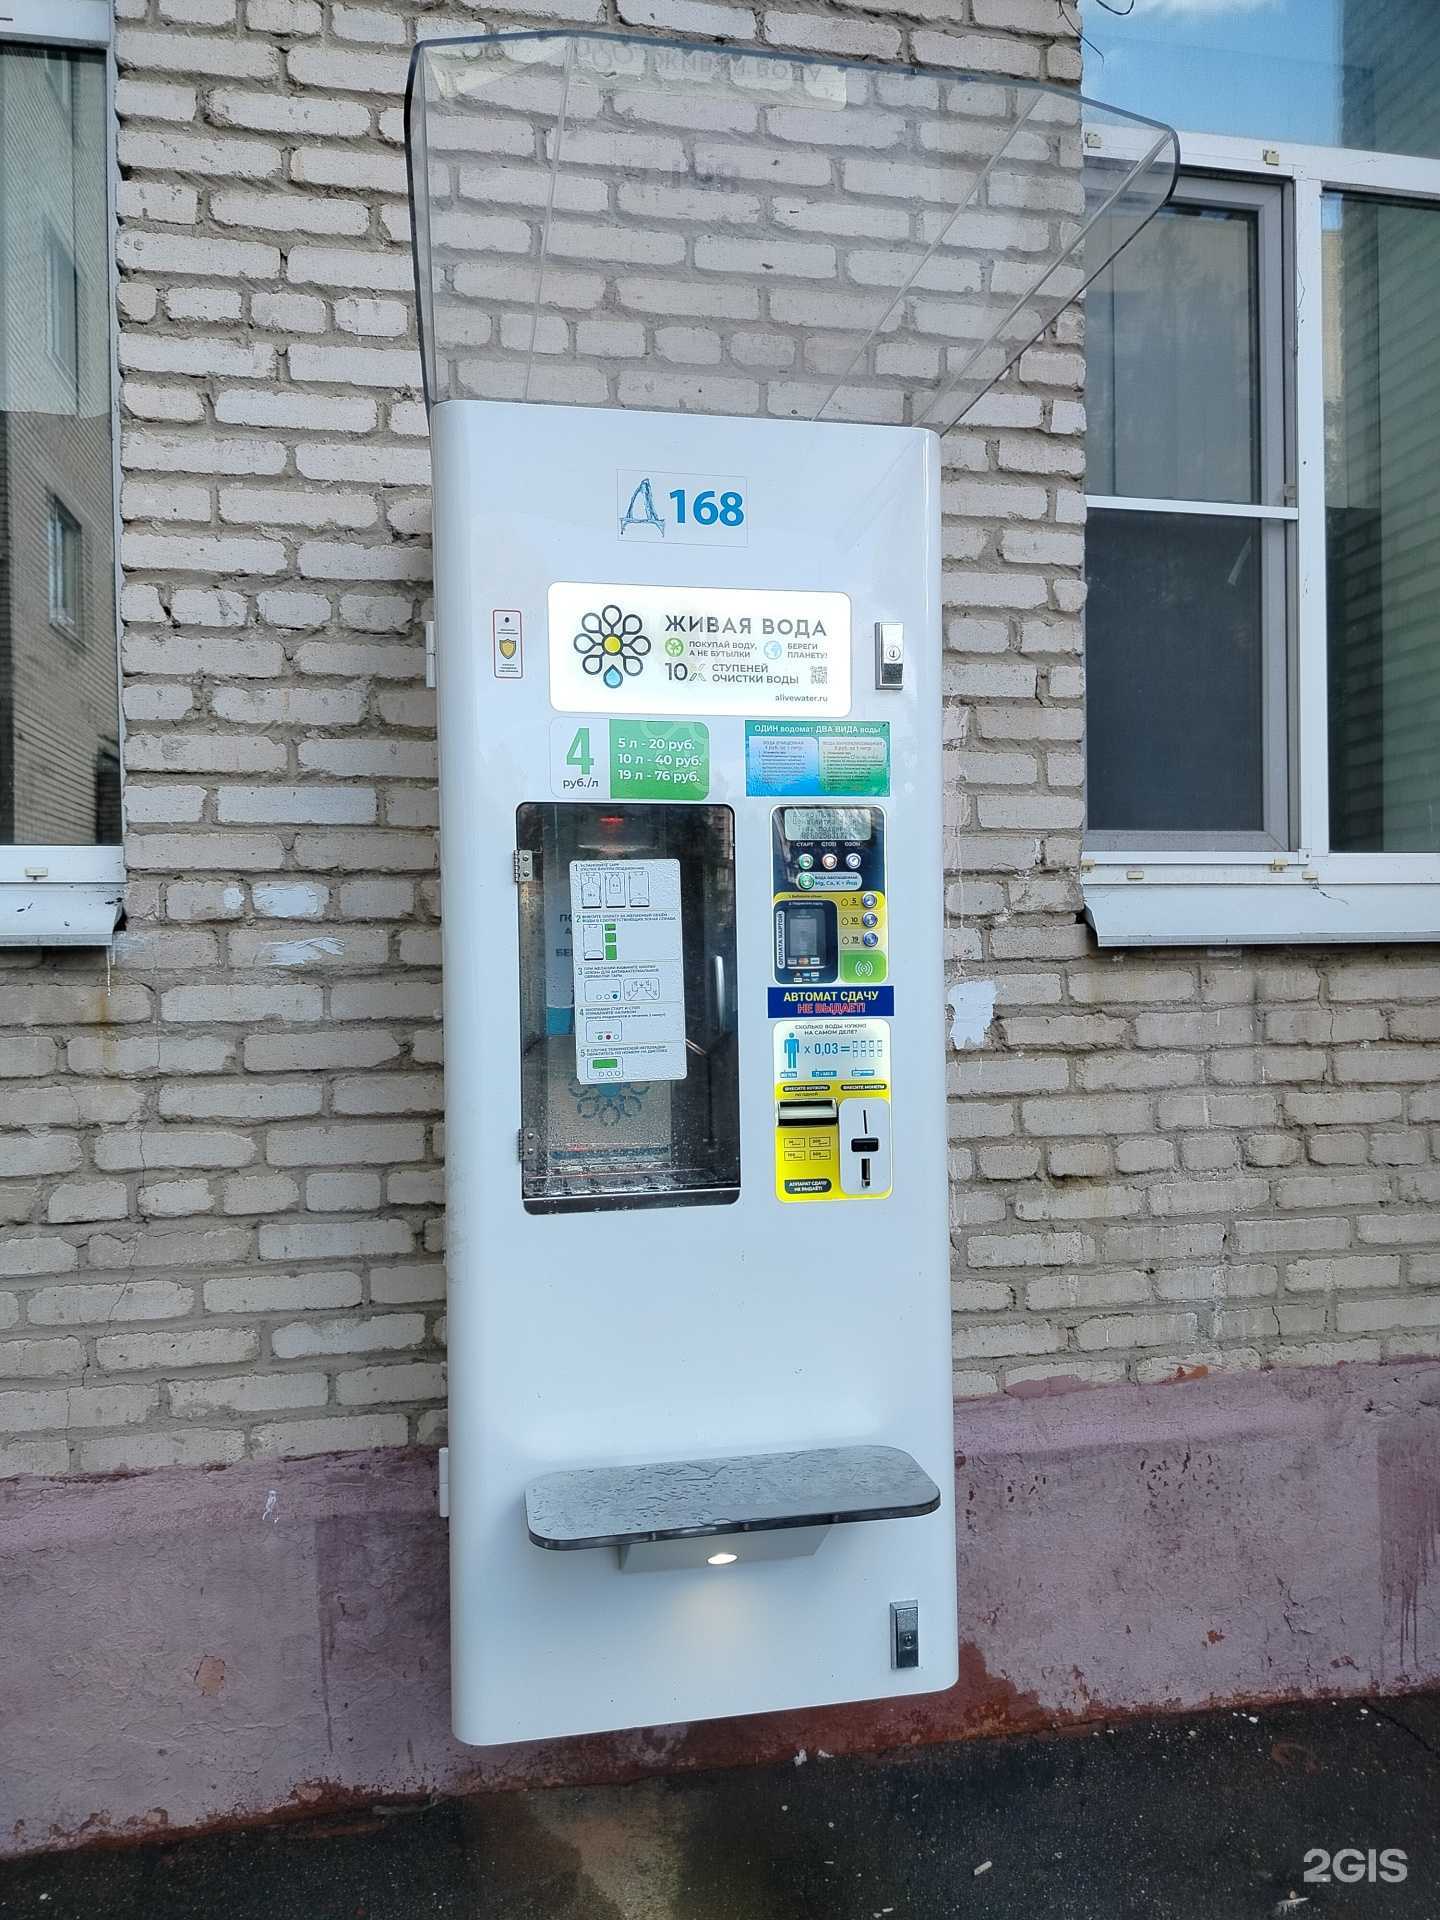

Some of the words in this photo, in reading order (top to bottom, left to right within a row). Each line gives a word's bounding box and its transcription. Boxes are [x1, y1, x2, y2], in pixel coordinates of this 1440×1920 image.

[664, 615, 751, 634] ЖИВАЯ
[762, 618, 827, 638] ВОДА
[689, 640, 730, 649] ПОКУПАЙ
[732, 642, 758, 650] ВОДУ,
[711, 650, 750, 658] БУТЫЛКИ
[787, 651, 828, 659] ПЛАНЕТУ!
[665, 663, 688, 681] 10
[712, 663, 768, 673] СТУПЕНЕЙ
[712, 674, 764, 683] ОЧИСТКИ
[767, 675, 799, 685] ВОДЫ
[775, 694, 828, 703] alivewater.ru
[754, 725, 779, 733] ОДИН
[815, 725, 833, 734] ДВА
[835, 726, 858, 734] ВИДА
[860, 727, 880, 735] воды
[618, 737, 626, 748] 5
[629, 740, 638, 748] л
[649, 738, 665, 749] 20
[668, 739, 695, 752] руб.
[566, 727, 595, 775] 4
[618, 753, 631, 764] 10
[635, 755, 644, 764] л
[655, 754, 672, 765] 40
[675, 755, 702, 768] руб.
[618, 769, 631, 780] 19
[635, 771, 644, 780] л
[655, 770, 671, 781] 76
[673, 771, 700, 784] руб.
[563, 777, 599, 789] руб./л
[576, 914, 580, 923] 2
[578, 968, 583, 976] 3
[783, 992, 838, 1002] АВТОМАТ
[840, 991, 879, 1003] СДАЧУ
[579, 1008, 584, 1016] 4
[797, 1003, 814, 1014] НЕ
[814, 1043, 839, 1056] 0,03
